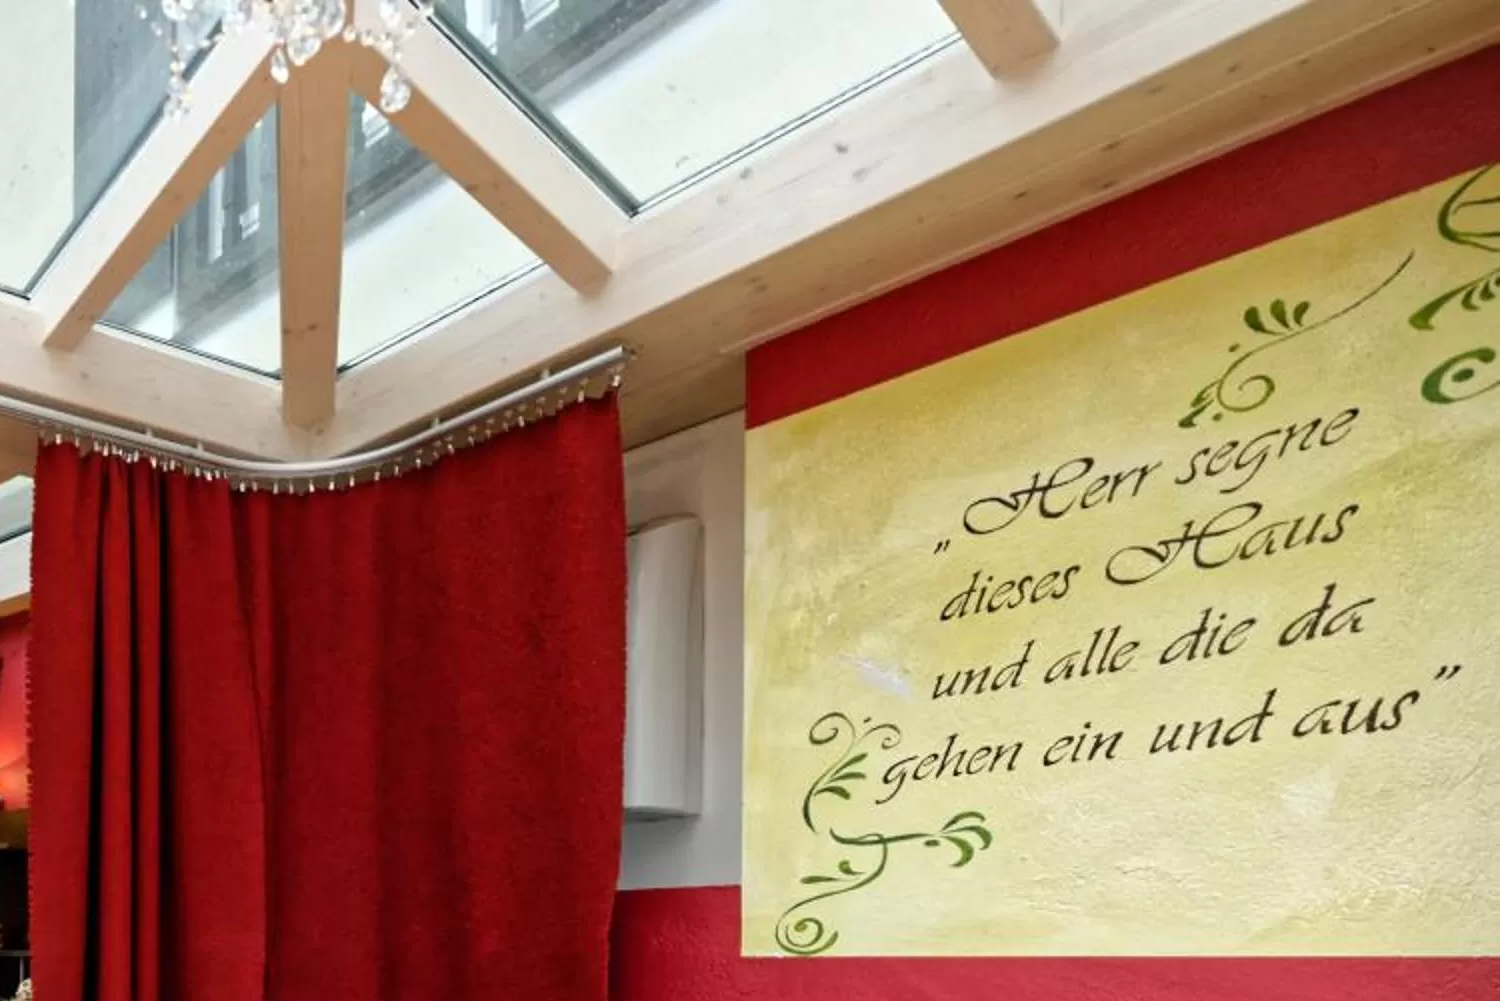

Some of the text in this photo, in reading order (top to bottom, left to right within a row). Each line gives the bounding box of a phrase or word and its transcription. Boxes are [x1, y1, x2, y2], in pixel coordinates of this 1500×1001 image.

[1174, 408, 1360, 494] segne
[939, 501, 1359, 621] dieses Haus
[931, 582, 1376, 700] und alle die da
[875, 733, 1023, 805] gehen
[1043, 722, 1124, 767] ein
[1149, 688, 1277, 754] und
